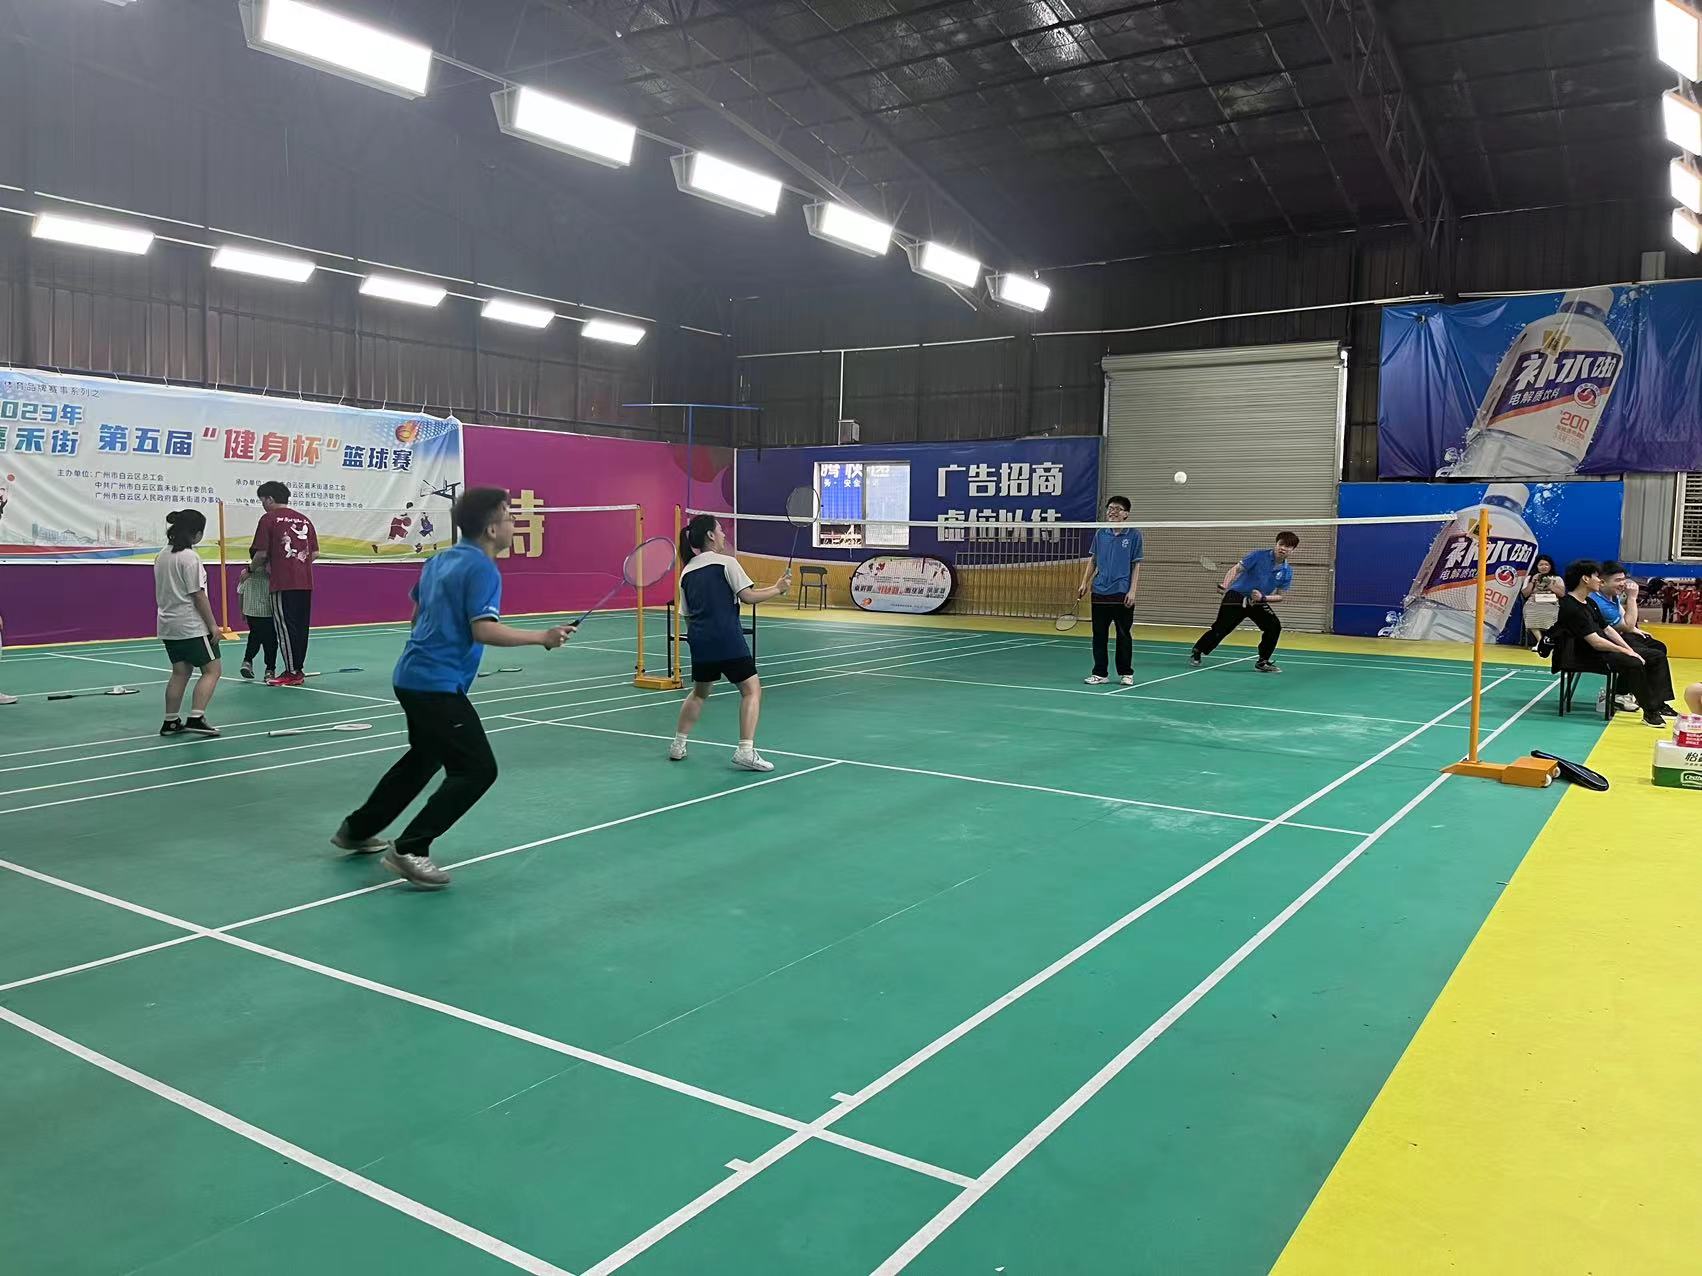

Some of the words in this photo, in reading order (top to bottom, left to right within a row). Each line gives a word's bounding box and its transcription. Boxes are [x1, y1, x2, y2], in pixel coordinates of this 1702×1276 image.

[1515, 353, 1617, 392] 补水啦
[1508, 388, 1560, 406] 电解质饮料
[1560, 411, 1590, 433] 200
[937, 462, 1063, 497] 广告招商
[937, 509, 1061, 542] 虚位以待
